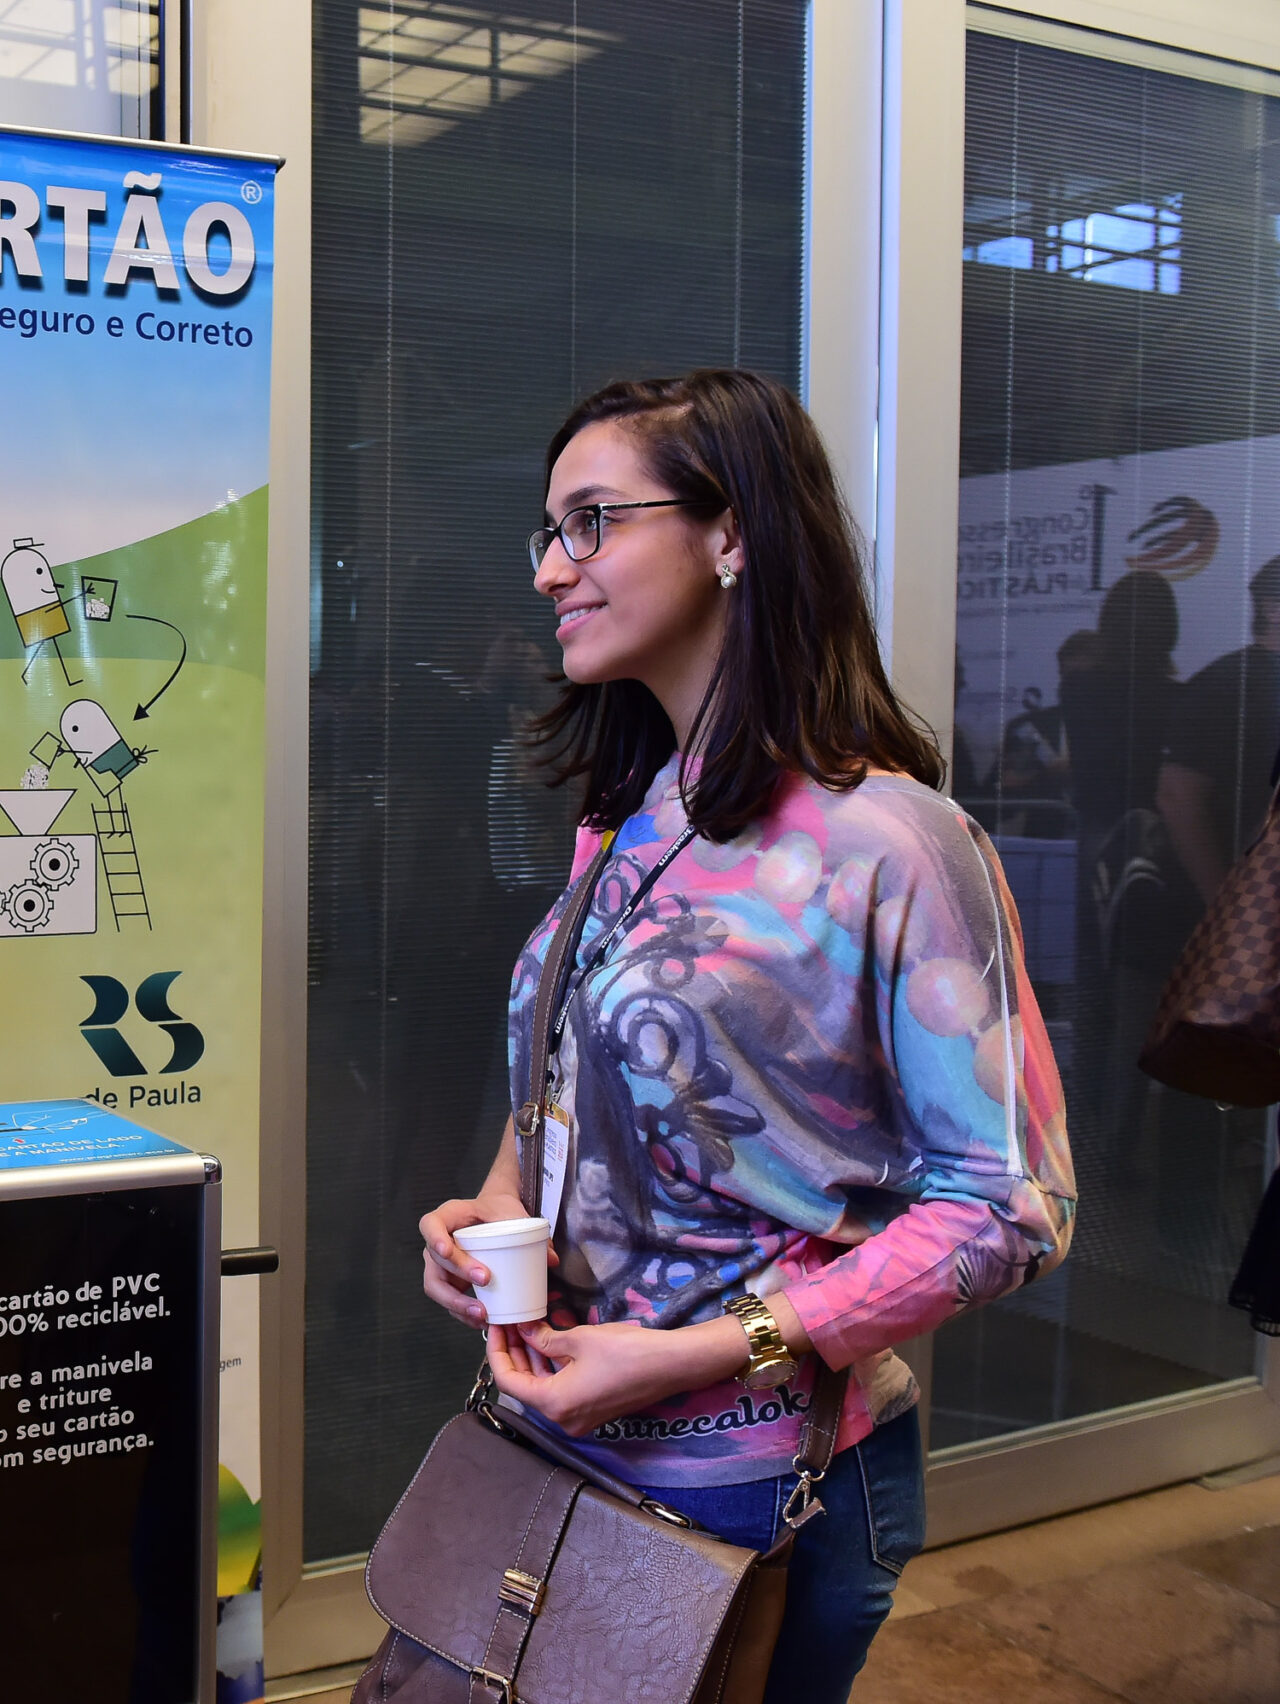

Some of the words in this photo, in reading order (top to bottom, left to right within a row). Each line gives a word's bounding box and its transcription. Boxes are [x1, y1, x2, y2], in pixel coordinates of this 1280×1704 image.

[106, 313, 125, 338] e
[134, 312, 254, 348] Correto
[78, 970, 205, 1077] RS
[85, 1087, 119, 1109] de
[129, 1080, 202, 1109] Paula
[68, 1138, 94, 1146] DE
[96, 1135, 144, 1146] LADO
[75, 1281, 103, 1302] de
[112, 1272, 161, 1298] PVC
[56, 1295, 172, 1330] reciclável.
[29, 1371, 43, 1386] a
[51, 1350, 154, 1384] manivela
[17, 1398, 31, 1414] e
[39, 1386, 113, 1411] triture
[16, 1420, 56, 1441] seu
[63, 1405, 135, 1433] cartão
[32, 1432, 155, 1466] segurança.
